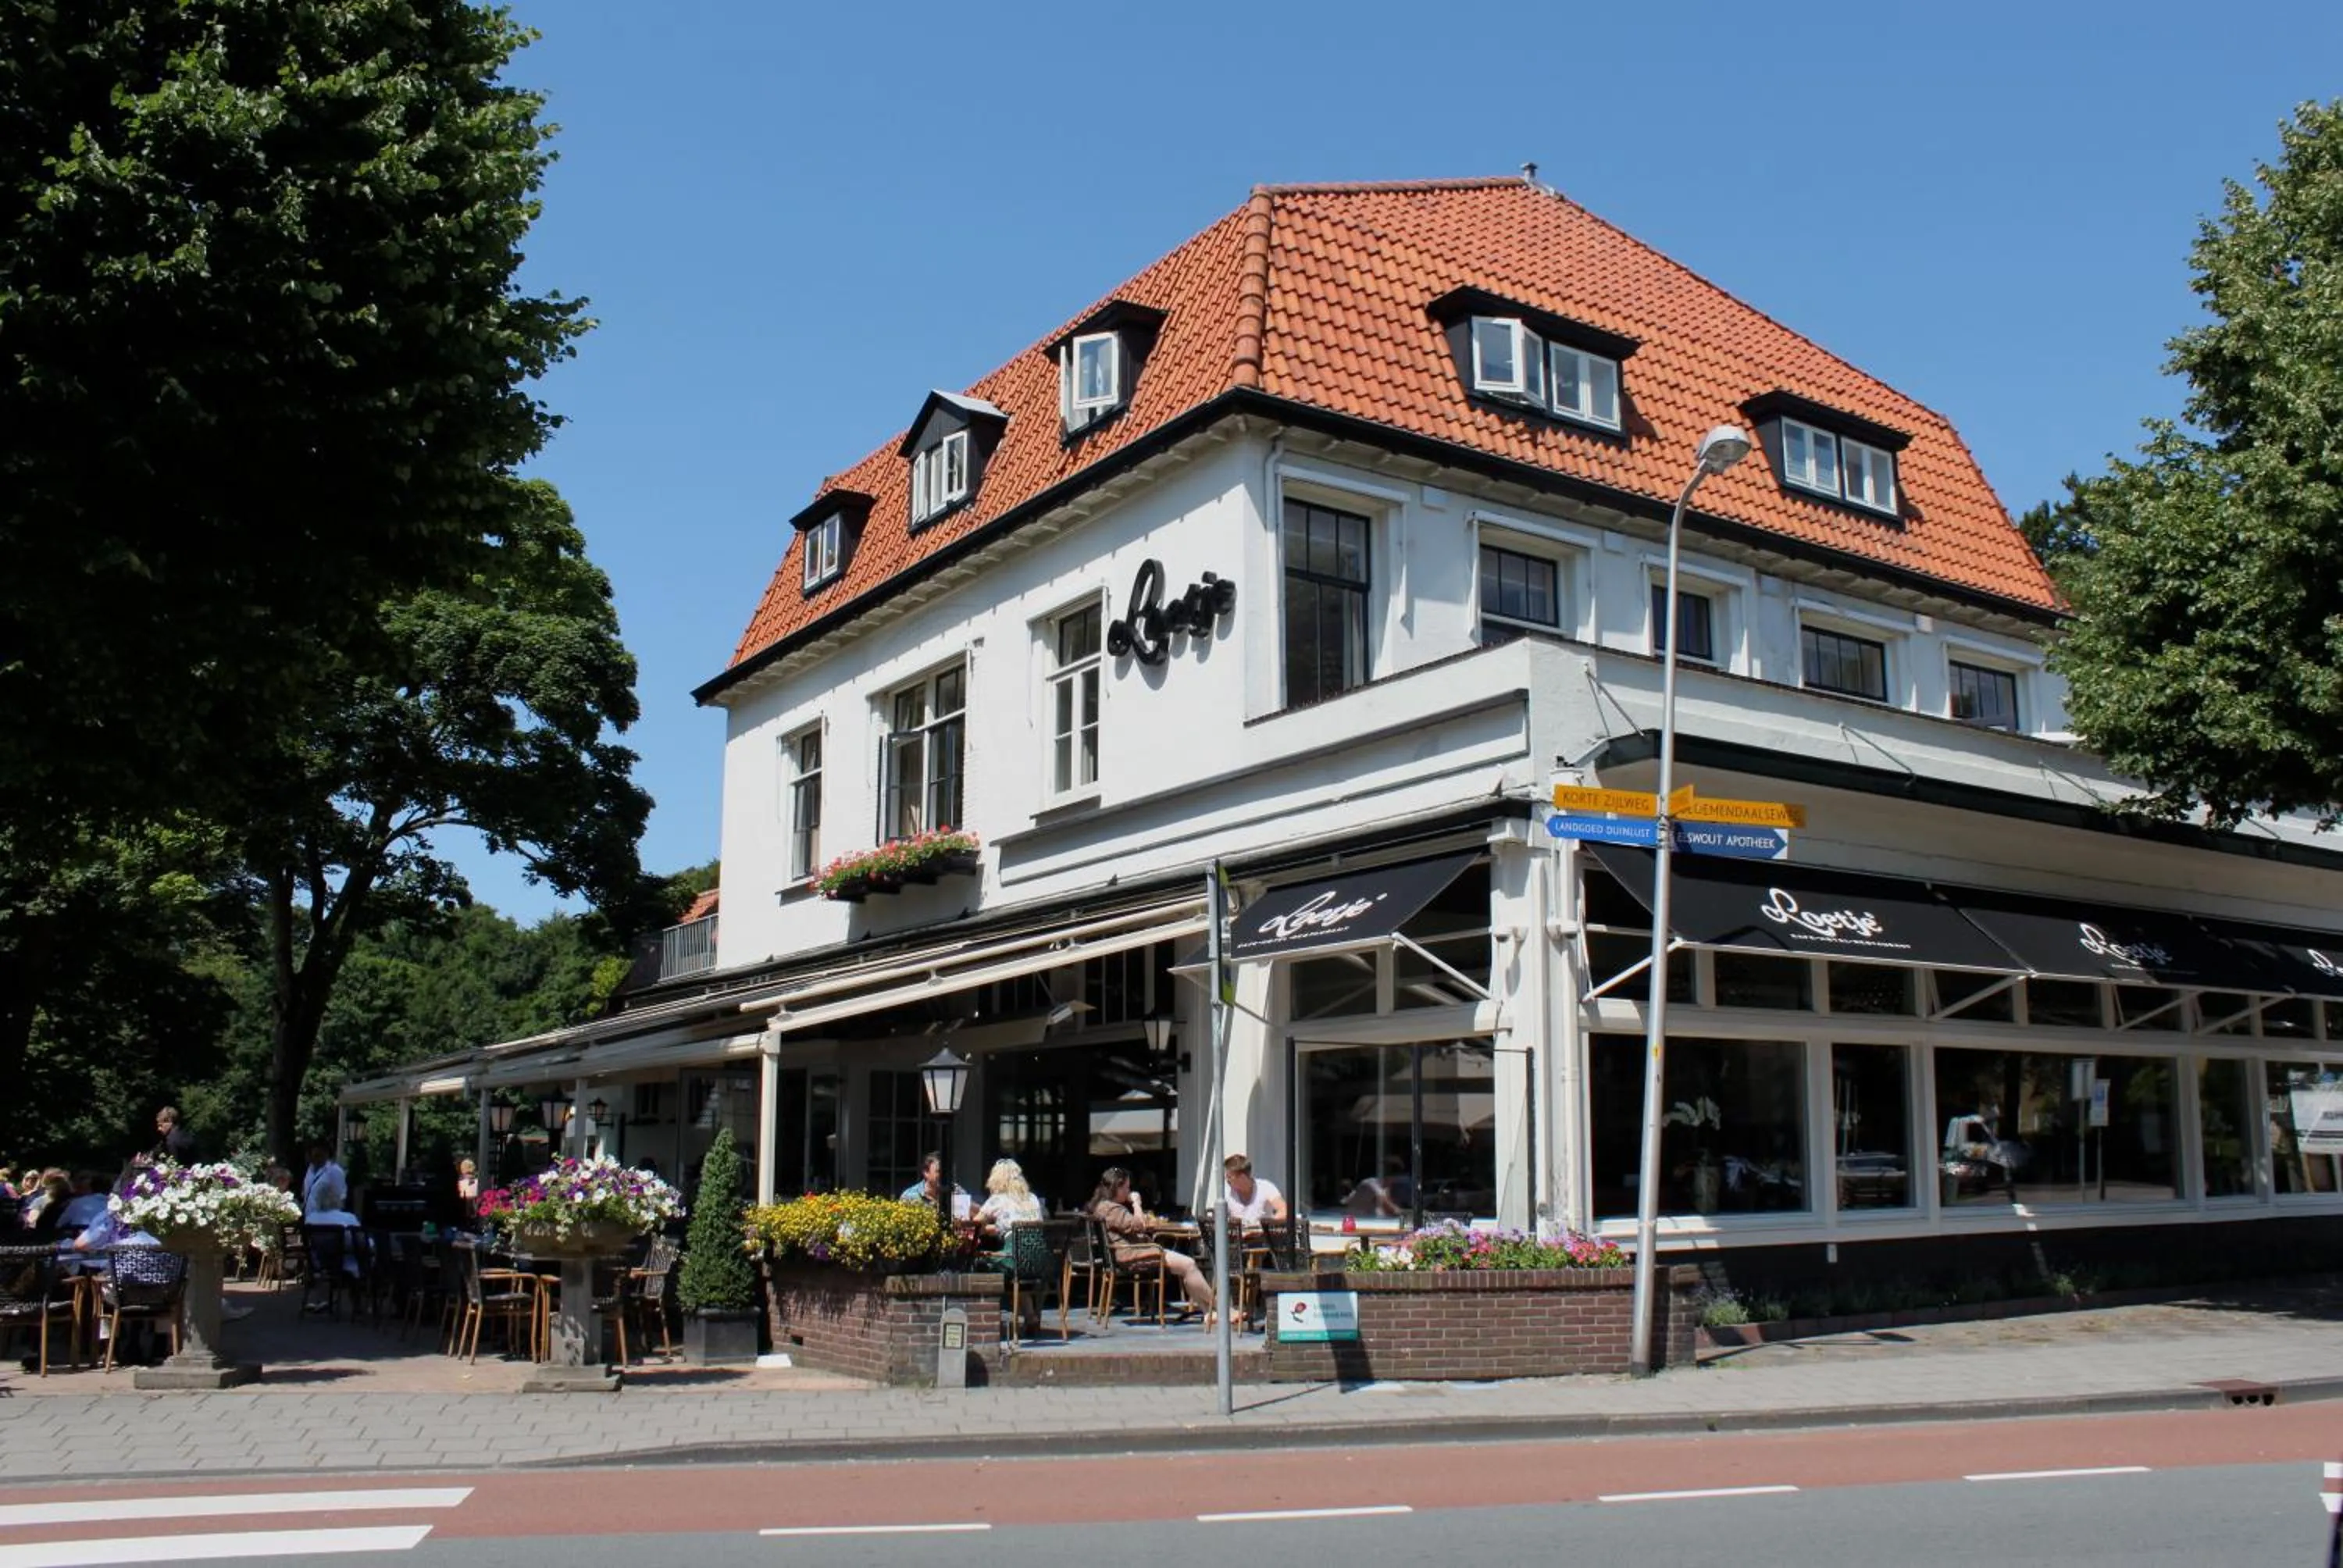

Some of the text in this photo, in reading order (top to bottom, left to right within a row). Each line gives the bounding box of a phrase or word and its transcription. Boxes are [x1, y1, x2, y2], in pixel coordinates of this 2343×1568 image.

[1563, 791, 1649, 811] KORTE ZIJLWEG
[1555, 821, 1650, 838] LANDGOED DUINLUST
[1725, 834, 1775, 849] APOTHEEK
[1760, 887, 1884, 937] Loetje
